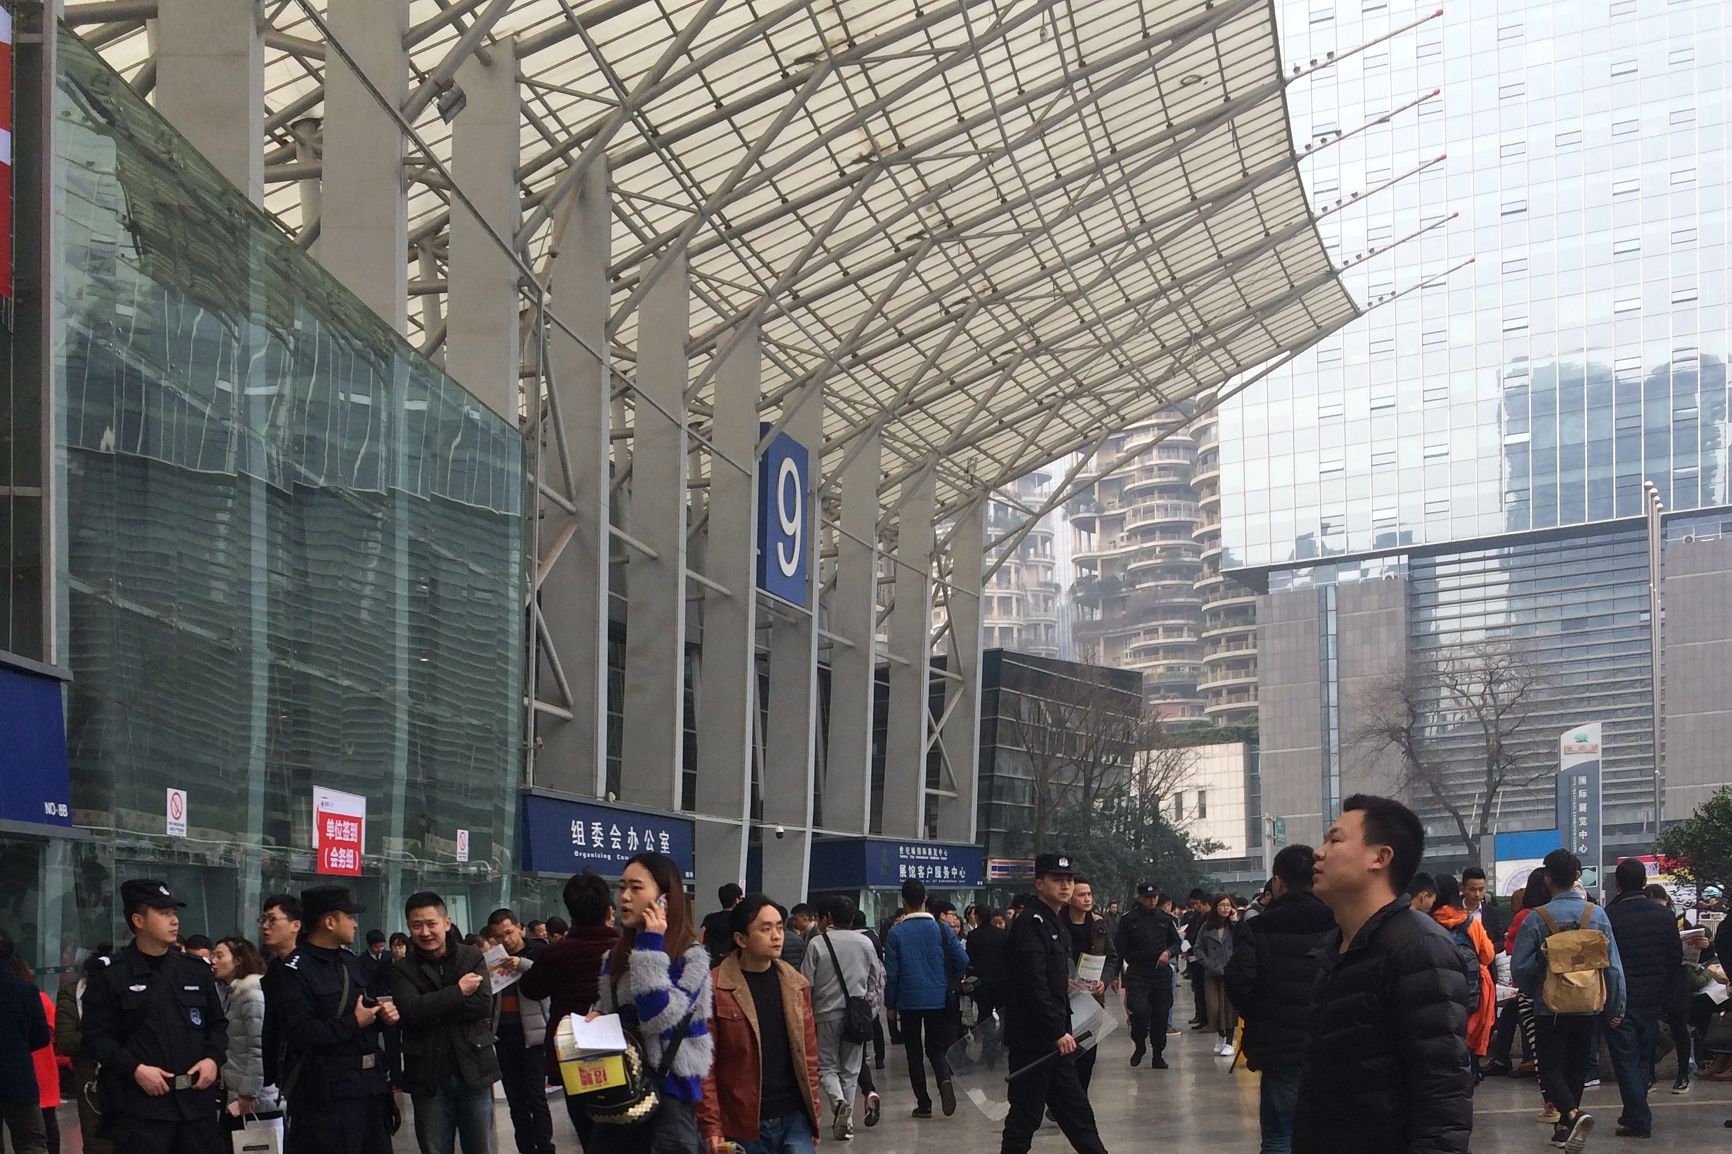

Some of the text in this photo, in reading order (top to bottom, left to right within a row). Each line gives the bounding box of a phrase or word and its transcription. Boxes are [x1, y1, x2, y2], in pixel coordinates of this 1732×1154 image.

[777, 457, 802, 577] 9
[570, 819, 671, 854] 组委会办公室
[899, 864, 966, 879] 展馆客户服务中心
